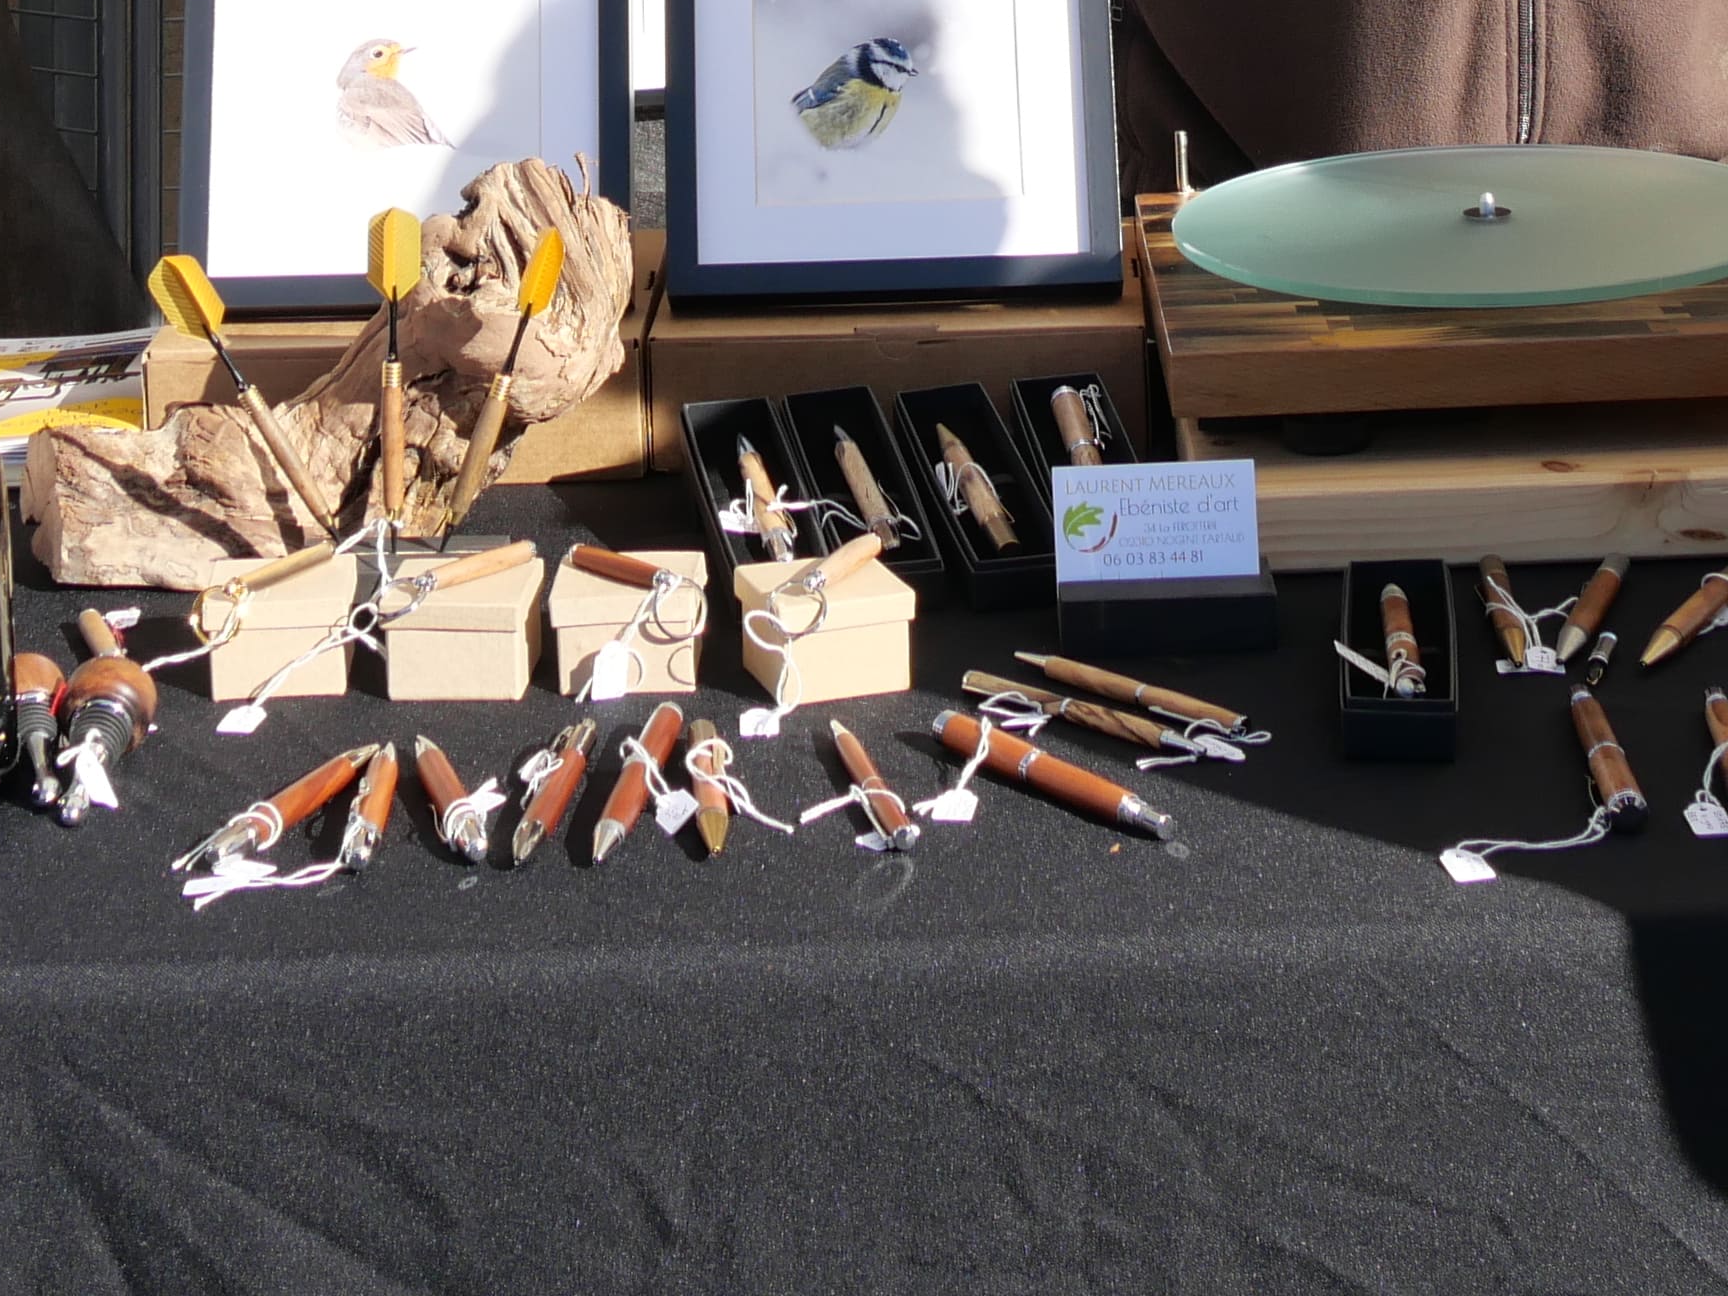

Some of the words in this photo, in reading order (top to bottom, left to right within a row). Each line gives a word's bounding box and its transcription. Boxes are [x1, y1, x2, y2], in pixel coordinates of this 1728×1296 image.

[1065, 478, 1144, 496] LAURENT
[1148, 473, 1236, 492] MEREAUX
[1119, 497, 1191, 517] Ebéniste
[1197, 494, 1239, 513] d'art
[1103, 553, 1122, 567] 06
[1126, 552, 1144, 566] 03
[1148, 551, 1166, 565] 83
[1170, 550, 1186, 564] 44
[1190, 549, 1204, 563] 81
